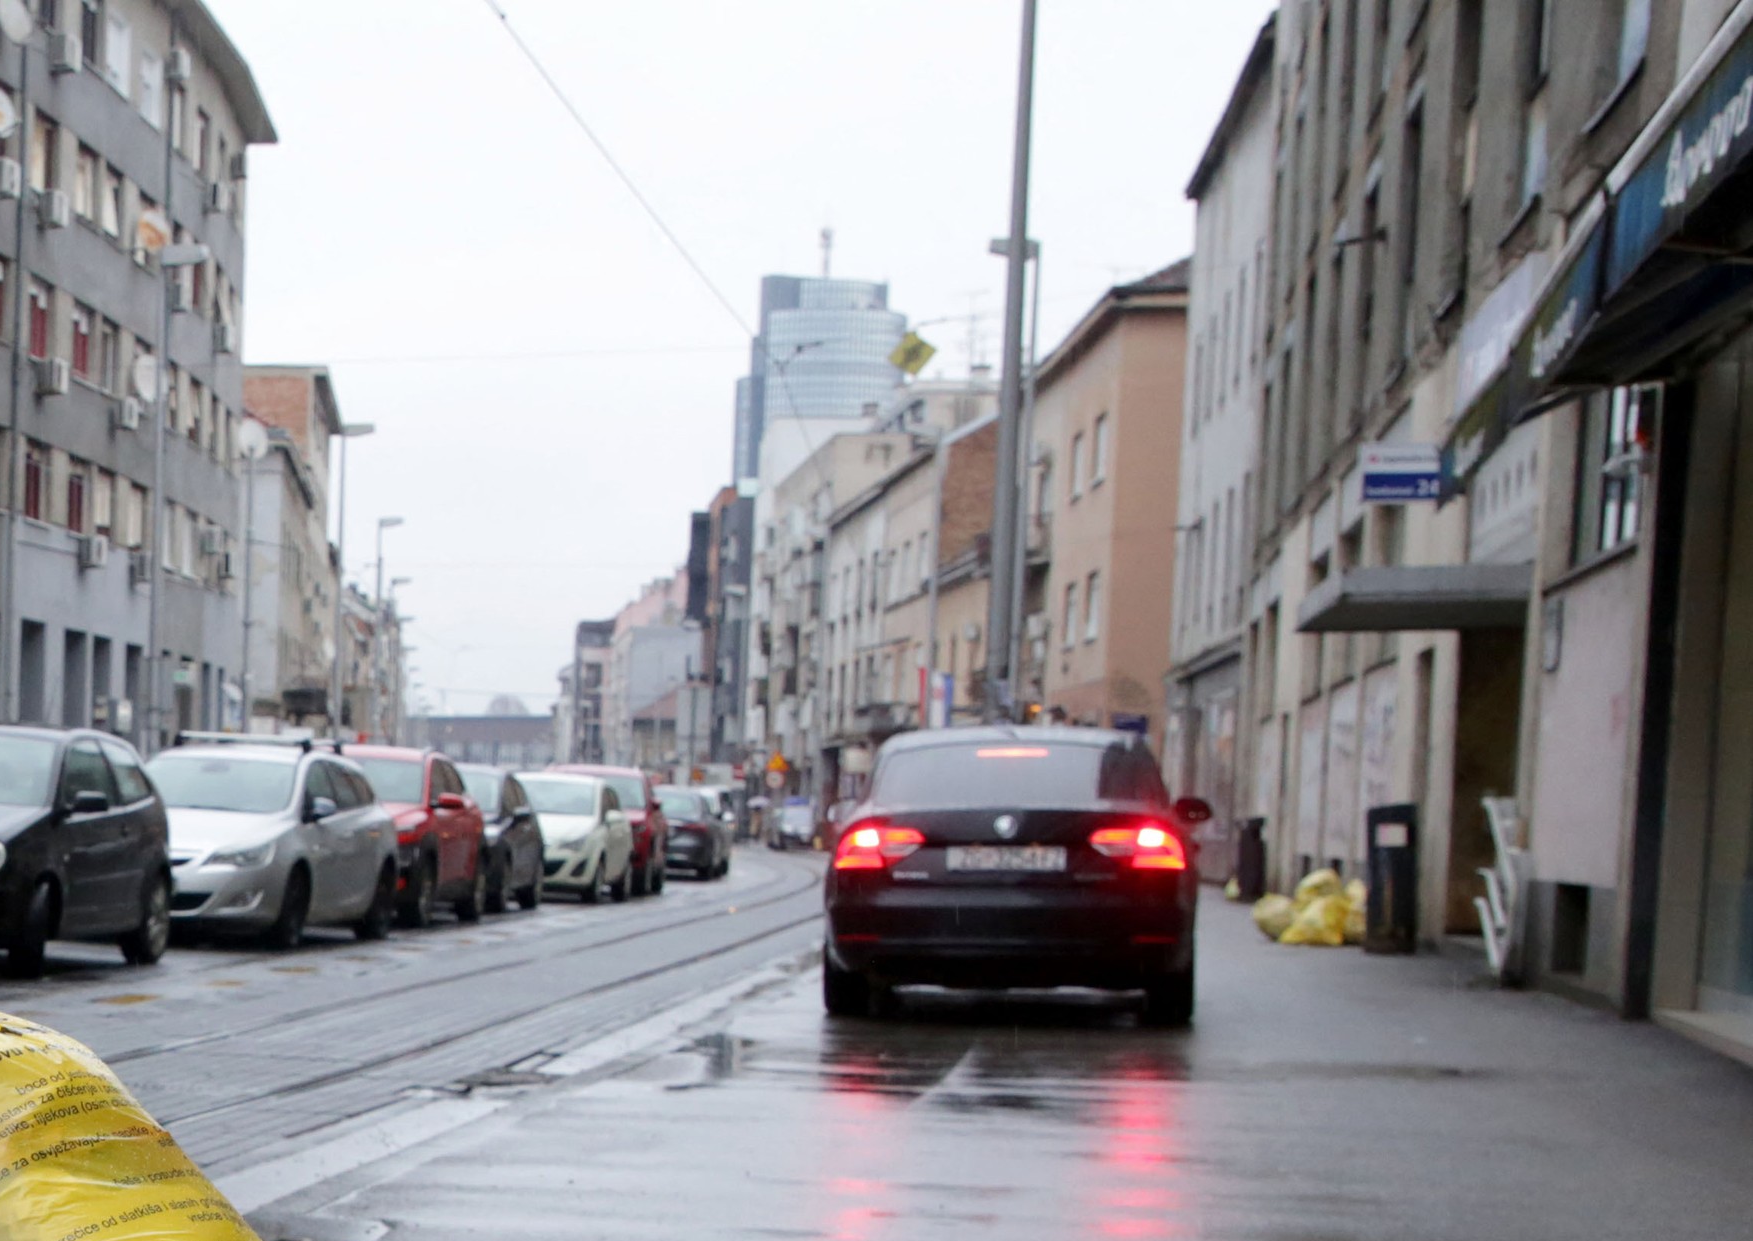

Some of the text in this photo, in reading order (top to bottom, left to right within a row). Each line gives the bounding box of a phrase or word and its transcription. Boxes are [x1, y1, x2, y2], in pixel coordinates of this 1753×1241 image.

[15, 1077, 48, 1096] boce
[49, 1070, 65, 1086] od
[41, 1090, 55, 1105] za
[35, 1101, 80, 1125] lijekova
[11, 1157, 29, 1172] za
[149, 1168, 186, 1184] posude
[101, 1216, 118, 1230] od
[118, 1204, 163, 1224] slatkiša
